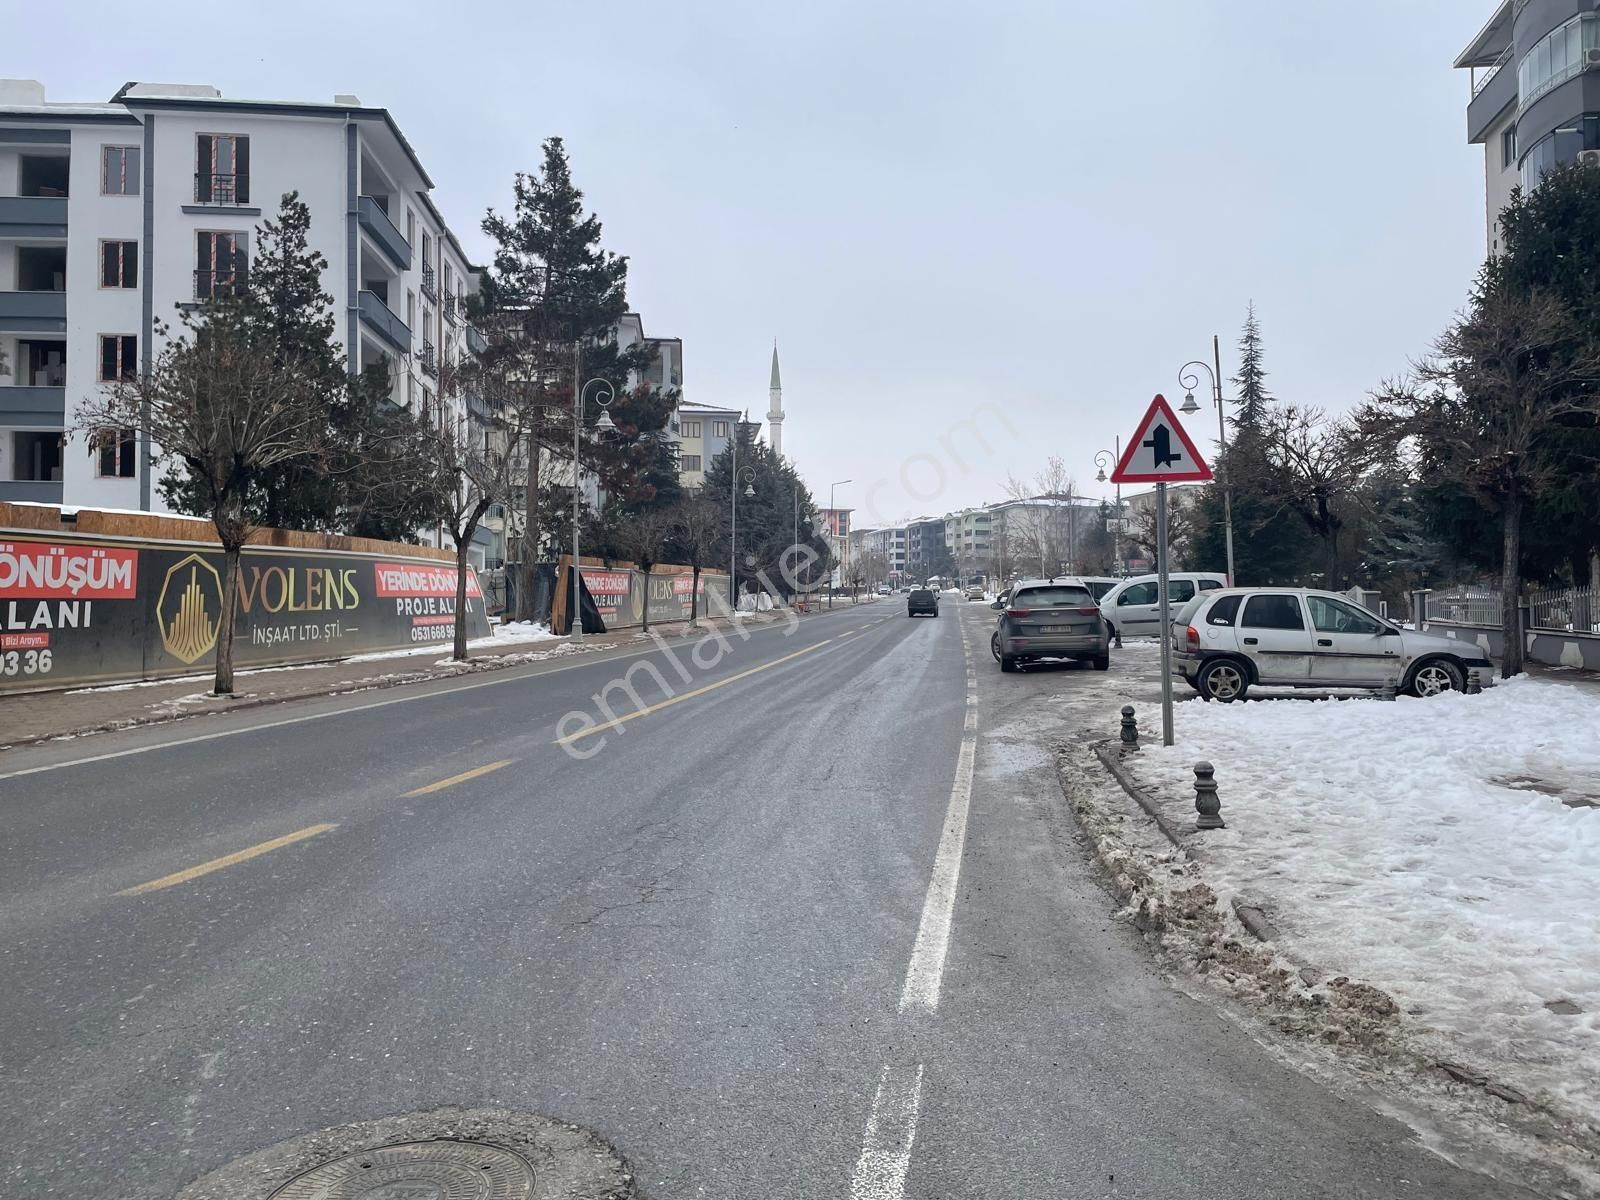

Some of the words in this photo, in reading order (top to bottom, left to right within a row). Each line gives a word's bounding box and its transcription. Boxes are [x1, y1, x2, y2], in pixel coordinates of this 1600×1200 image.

[237, 566, 359, 613] VOLENS
[378, 566, 429, 591] YERİNDE
[428, 568, 478, 593] DÖNÜM
[0, 601, 92, 630] LANI
[397, 597, 436, 616] PROJE
[440, 597, 473, 614] ALI
[253, 624, 297, 647] İNŞAAT
[300, 624, 322, 641] LTD.
[324, 620, 342, 643] ŞTİ.
[411, 627, 431, 641] 0531
[431, 625, 446, 639] 668
[24, 649, 53, 674] 36
